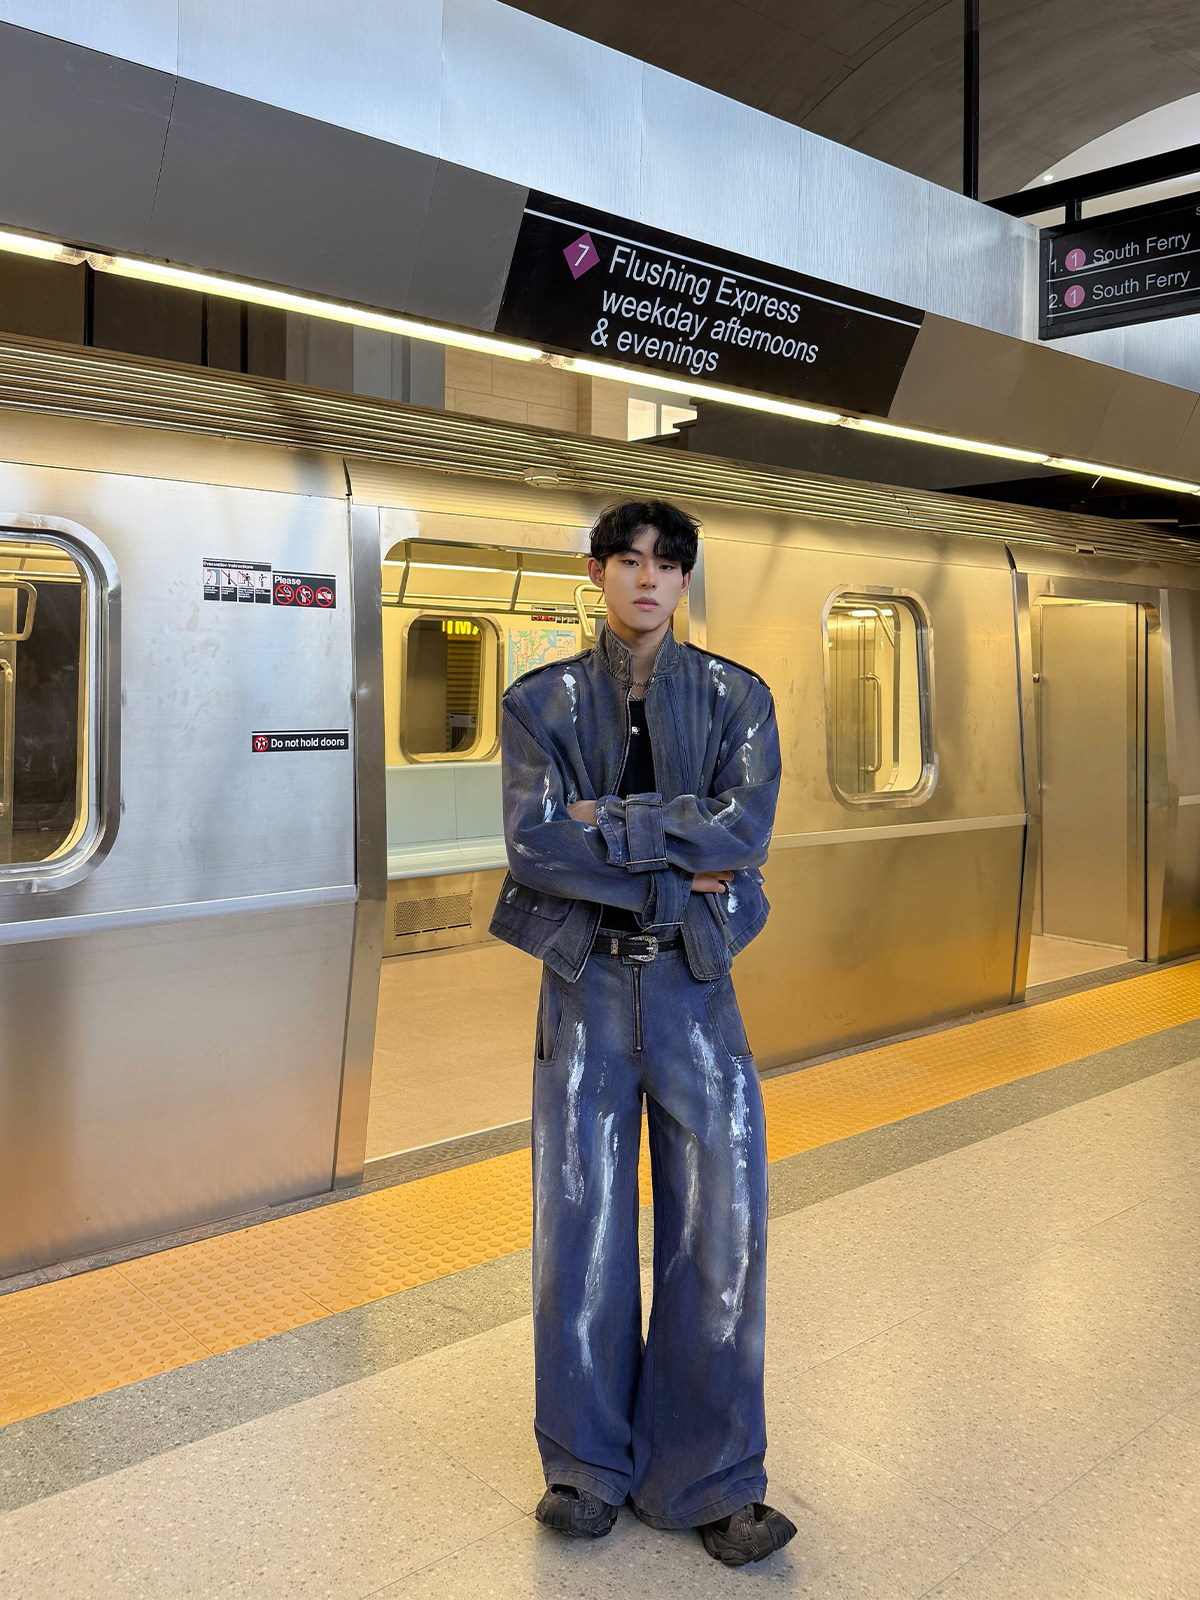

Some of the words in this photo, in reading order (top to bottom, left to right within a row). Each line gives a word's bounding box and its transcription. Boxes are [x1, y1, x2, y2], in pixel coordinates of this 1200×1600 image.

[1071, 252, 1079, 267] 1
[1092, 241, 1140, 264] South
[1146, 232, 1192, 254] Ferry
[574, 243, 590, 267] 7
[609, 245, 712, 305] Flushing
[715, 276, 801, 324] Express
[1070, 289, 1077, 304] 1
[1092, 278, 1140, 300] South
[1145, 270, 1191, 290] Ferry
[602, 290, 708, 341] weekday
[710, 316, 819, 363] afternoons
[590, 317, 609, 348] &
[616, 330, 719, 375] evenings
[274, 575, 302, 586] Please
[271, 738, 283, 748] Do
[285, 738, 299, 748] not
[300, 737, 319, 747] hold
[320, 737, 345, 747] doors
